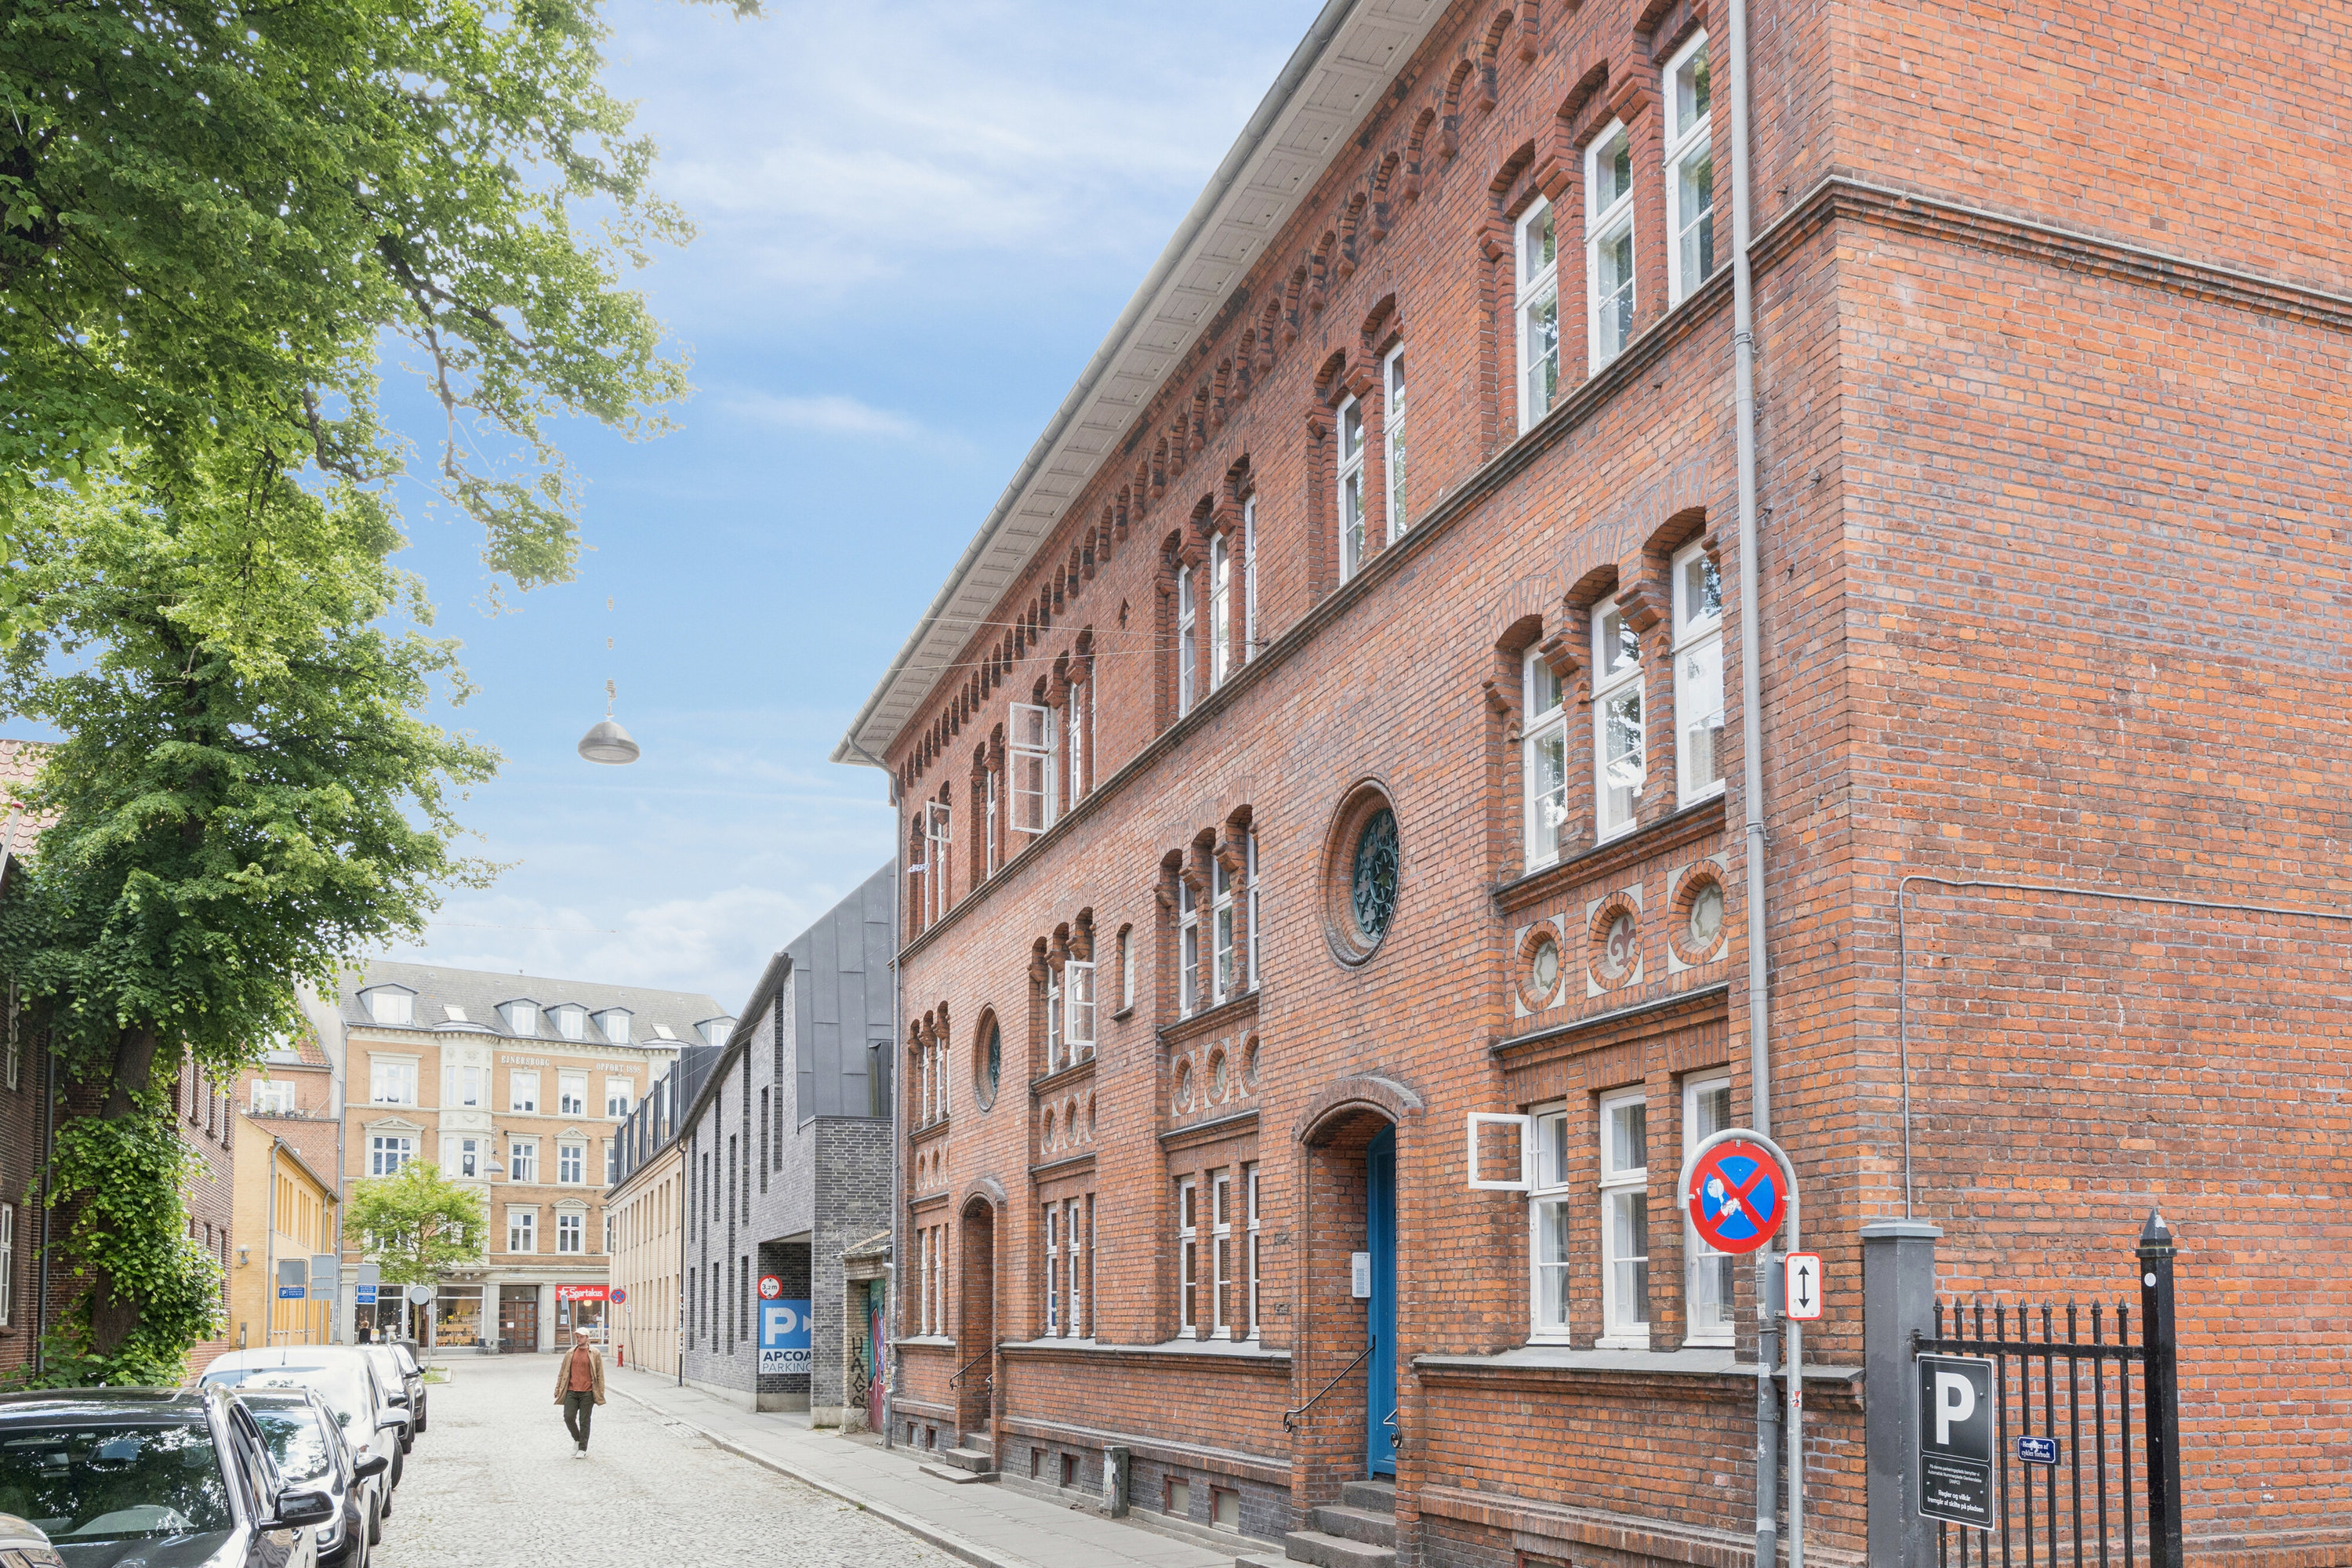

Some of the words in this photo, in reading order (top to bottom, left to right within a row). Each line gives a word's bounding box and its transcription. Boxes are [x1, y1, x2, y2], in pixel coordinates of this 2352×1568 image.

[501, 1055, 550, 1066] EJNERSBORG
[626, 1065, 641, 1073] 1898
[569, 1287, 603, 1300] Spartakus
[765, 1307, 797, 1345] P
[763, 1351, 811, 1362] APCOA
[1936, 1371, 1976, 1445] P
[1938, 1490, 1952, 1498] Regler
[1927, 1495, 1944, 1505] fremgår
[1966, 1504, 1984, 1513] pladsen
